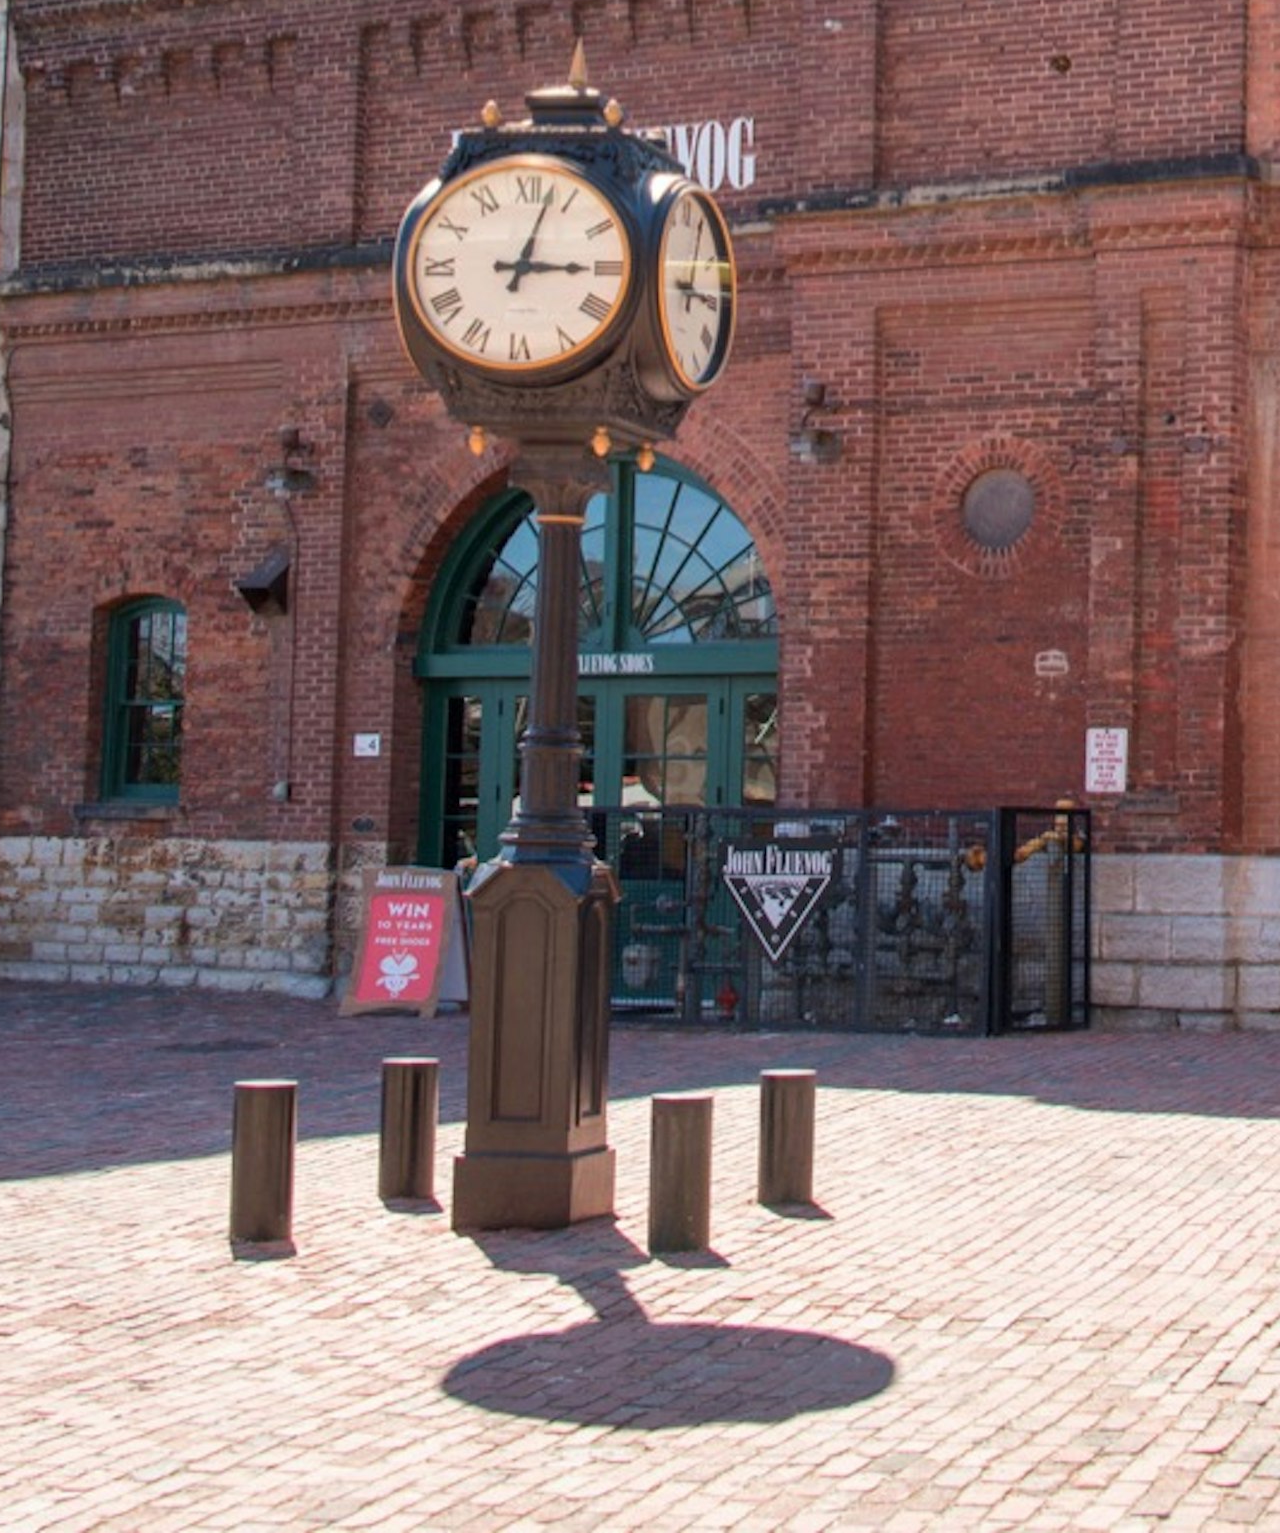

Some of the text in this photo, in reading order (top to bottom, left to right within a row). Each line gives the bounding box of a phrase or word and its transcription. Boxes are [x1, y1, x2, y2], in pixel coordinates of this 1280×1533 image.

[471, 184, 499, 217] XI
[516, 176, 542, 204] XII
[438, 217, 469, 241] X
[585, 218, 614, 240] II
[424, 256, 455, 276] IX
[430, 287, 464, 325] VIII
[461, 317, 492, 353] VII
[509, 332, 531, 360] VI
[723, 845, 832, 874] JOHN FLUEVOG
[388, 902, 430, 918] WIN
[396, 921, 432, 931] YEARS
